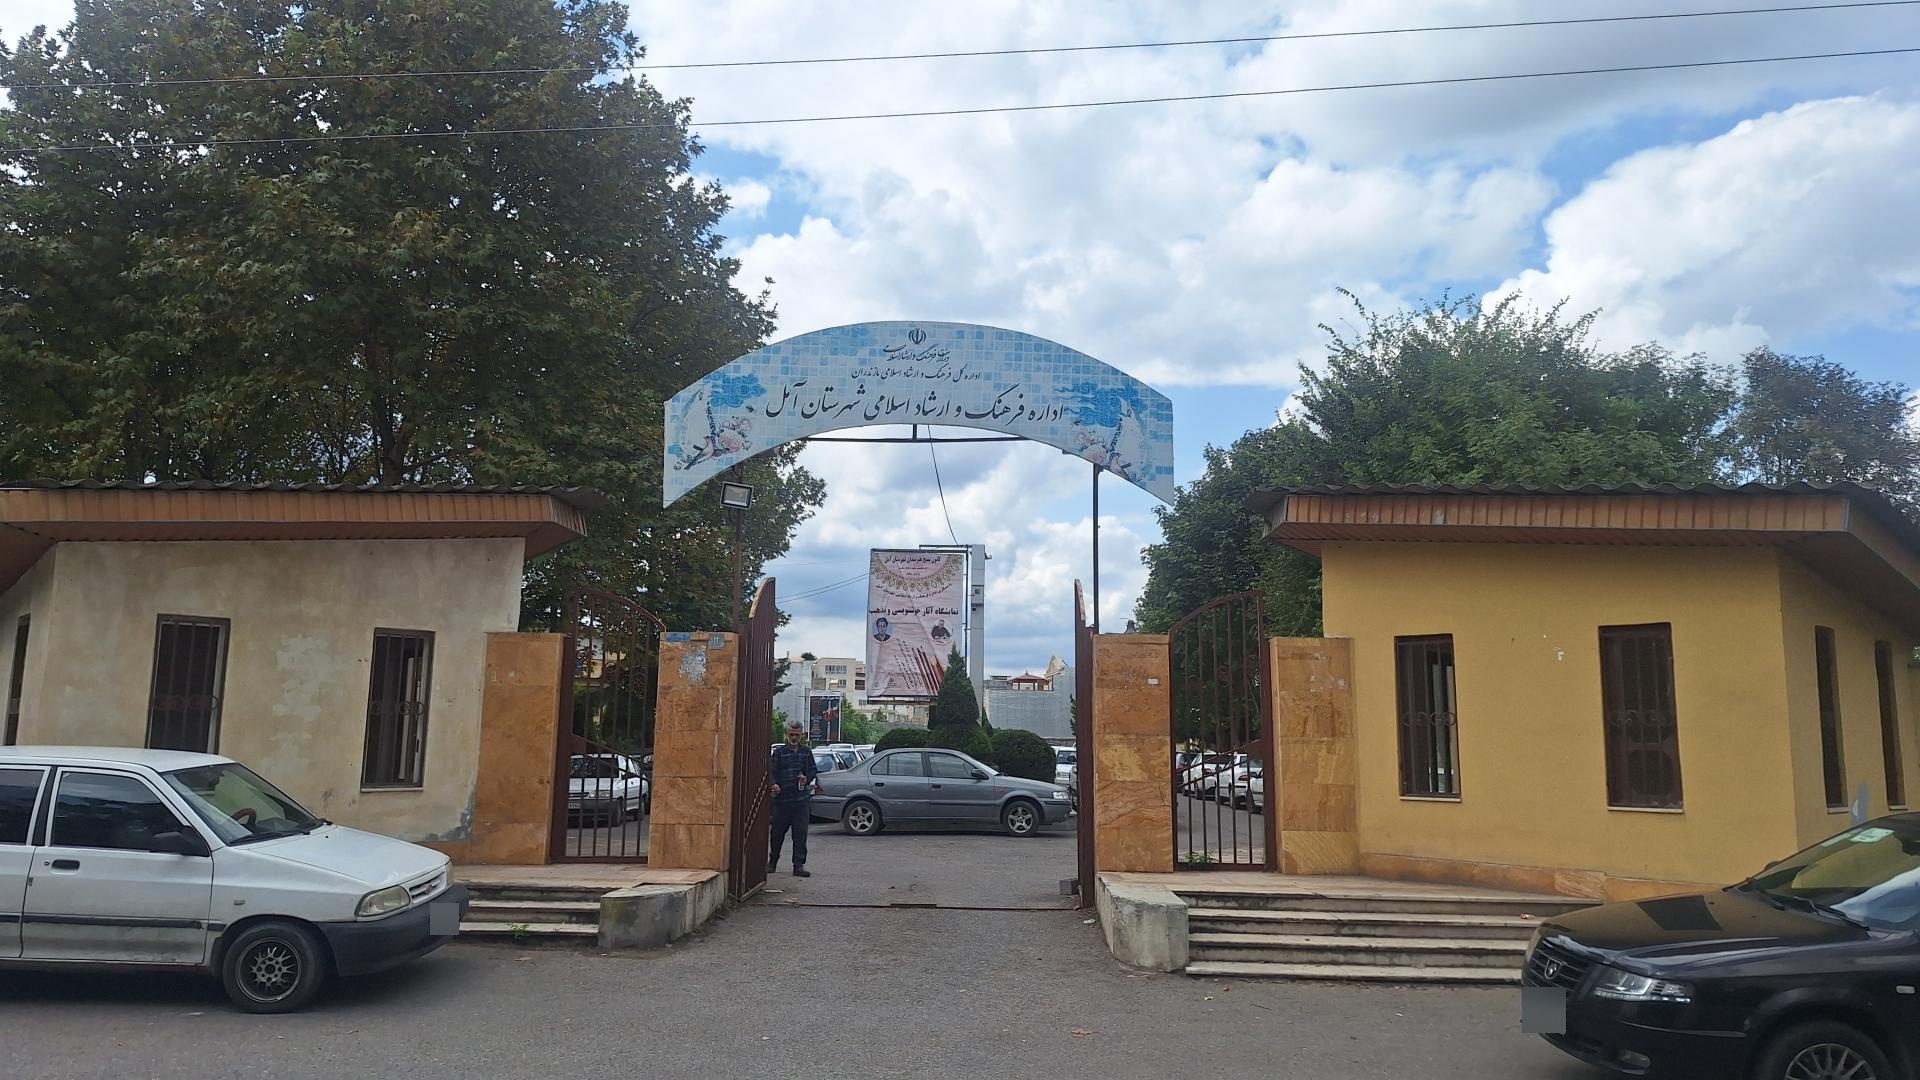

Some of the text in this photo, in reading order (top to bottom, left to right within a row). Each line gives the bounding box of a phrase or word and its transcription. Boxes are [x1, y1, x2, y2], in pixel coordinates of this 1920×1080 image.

[882, 344, 906, 361] اسلامی
[900, 350, 912, 360] ارشاد
[916, 344, 939, 362] فرهنگ
[936, 348, 950, 363] وزارت
[851, 366, 879, 379] مازندران
[880, 367, 901, 380] اسلامی
[903, 366, 919, 378] ارشاد
[925, 363, 952, 381] فرهنگ
[952, 363, 968, 382] کل
[964, 371, 981, 381] اداره
[765, 380, 1065, 427] اداره فرهنگ و ارشاد اسلامی شهرستان آمل
[891, 606, 921, 616] خوشنویسی
[922, 606, 933, 617] آثار
[934, 606, 959, 616] نمایشگاه
